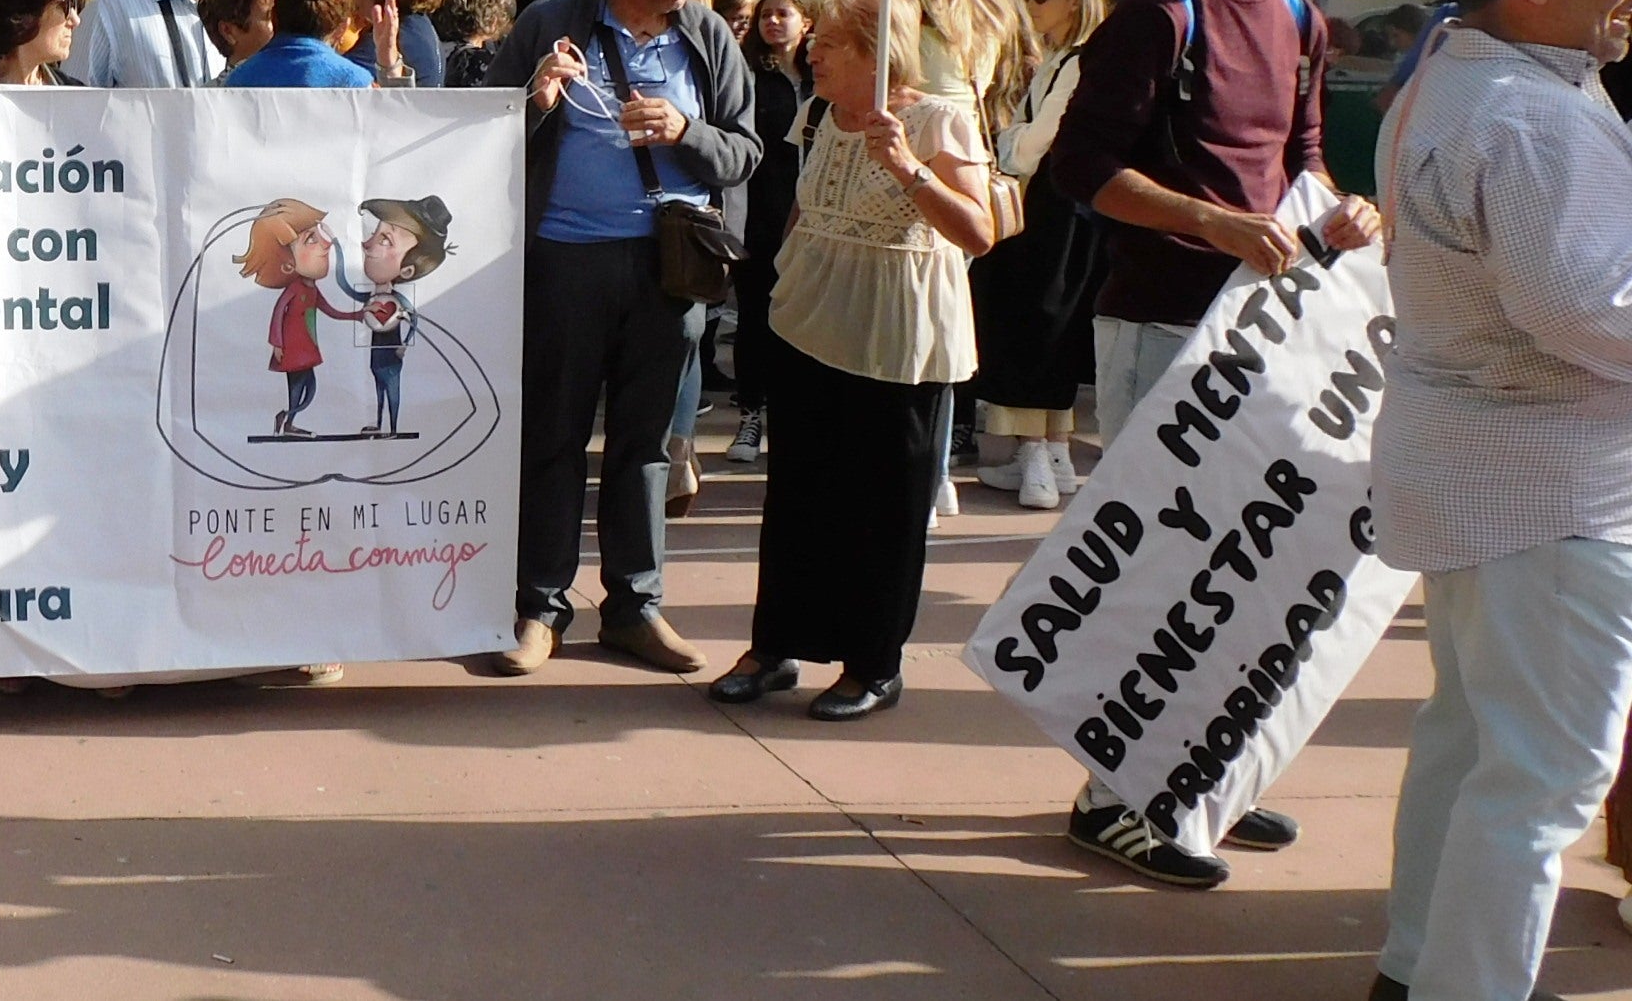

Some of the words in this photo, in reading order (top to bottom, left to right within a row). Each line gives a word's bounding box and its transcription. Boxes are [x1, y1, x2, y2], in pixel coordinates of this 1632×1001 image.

[7, 227, 97, 261] con
[0, 448, 30, 492] y
[995, 501, 1144, 691] SALUD
[1157, 225, 1342, 467] MENTAL
[189, 508, 275, 535] PONTE
[301, 506, 331, 532] EN
[353, 503, 380, 530] MI
[406, 500, 487, 526] LUGAR
[1158, 486, 1211, 541] Y
[170, 533, 328, 580] Conecta
[349, 539, 488, 610] conmigo
[1074, 459, 1317, 772] BIENESTAR
[1144, 569, 1347, 839] PRIORIDAD
